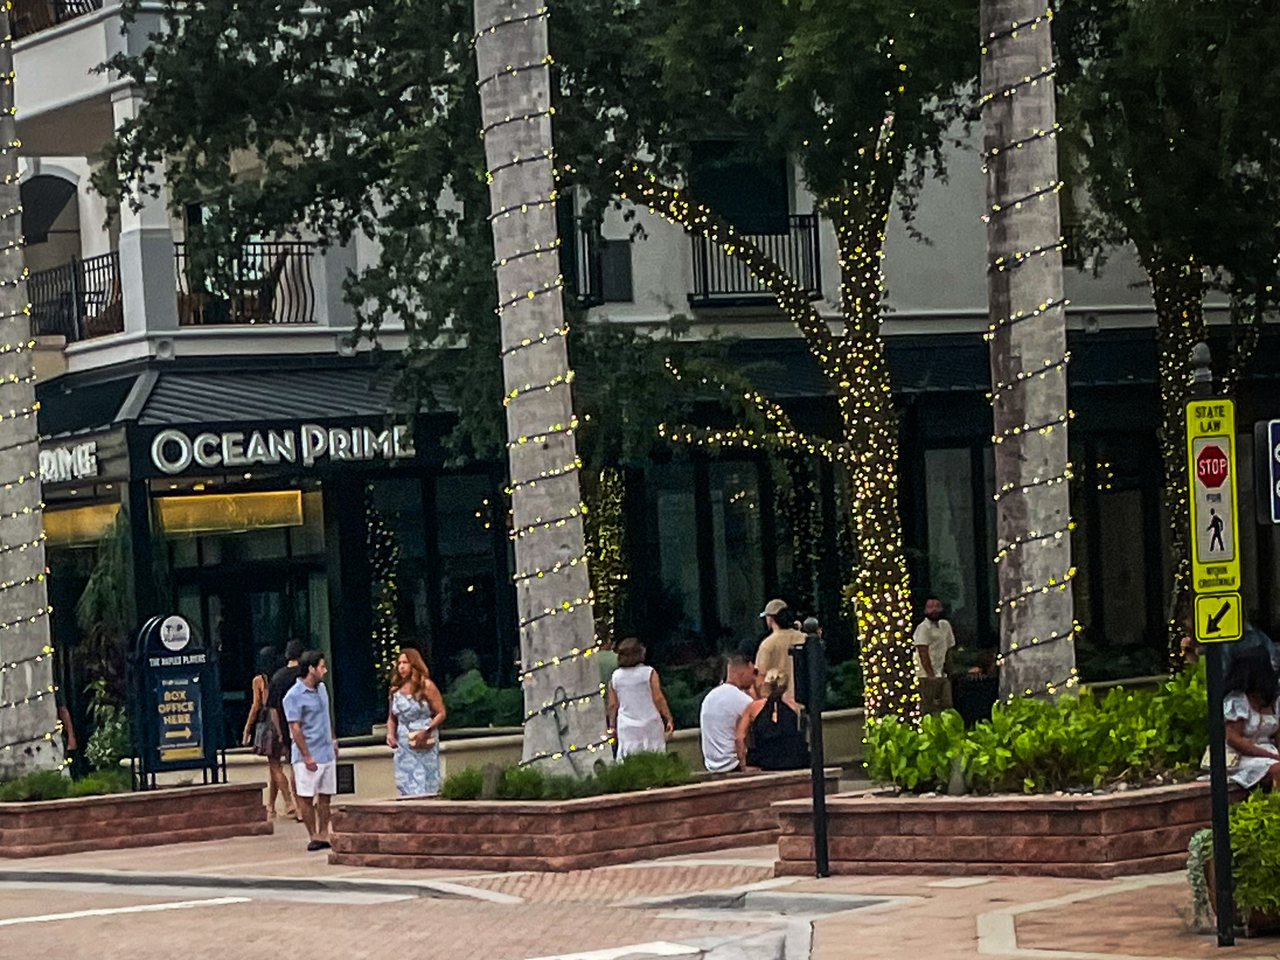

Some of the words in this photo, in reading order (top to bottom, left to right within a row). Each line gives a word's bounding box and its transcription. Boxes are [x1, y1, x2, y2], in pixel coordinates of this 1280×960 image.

[1195, 405, 1226, 419] STATE
[1200, 420, 1222, 433] LAW
[150, 428, 297, 475] OCEAN
[300, 423, 417, 468] PRIME
[1198, 458, 1228, 475] STOP
[164, 690, 187, 701] BOX
[158, 701, 195, 714] OFFICE
